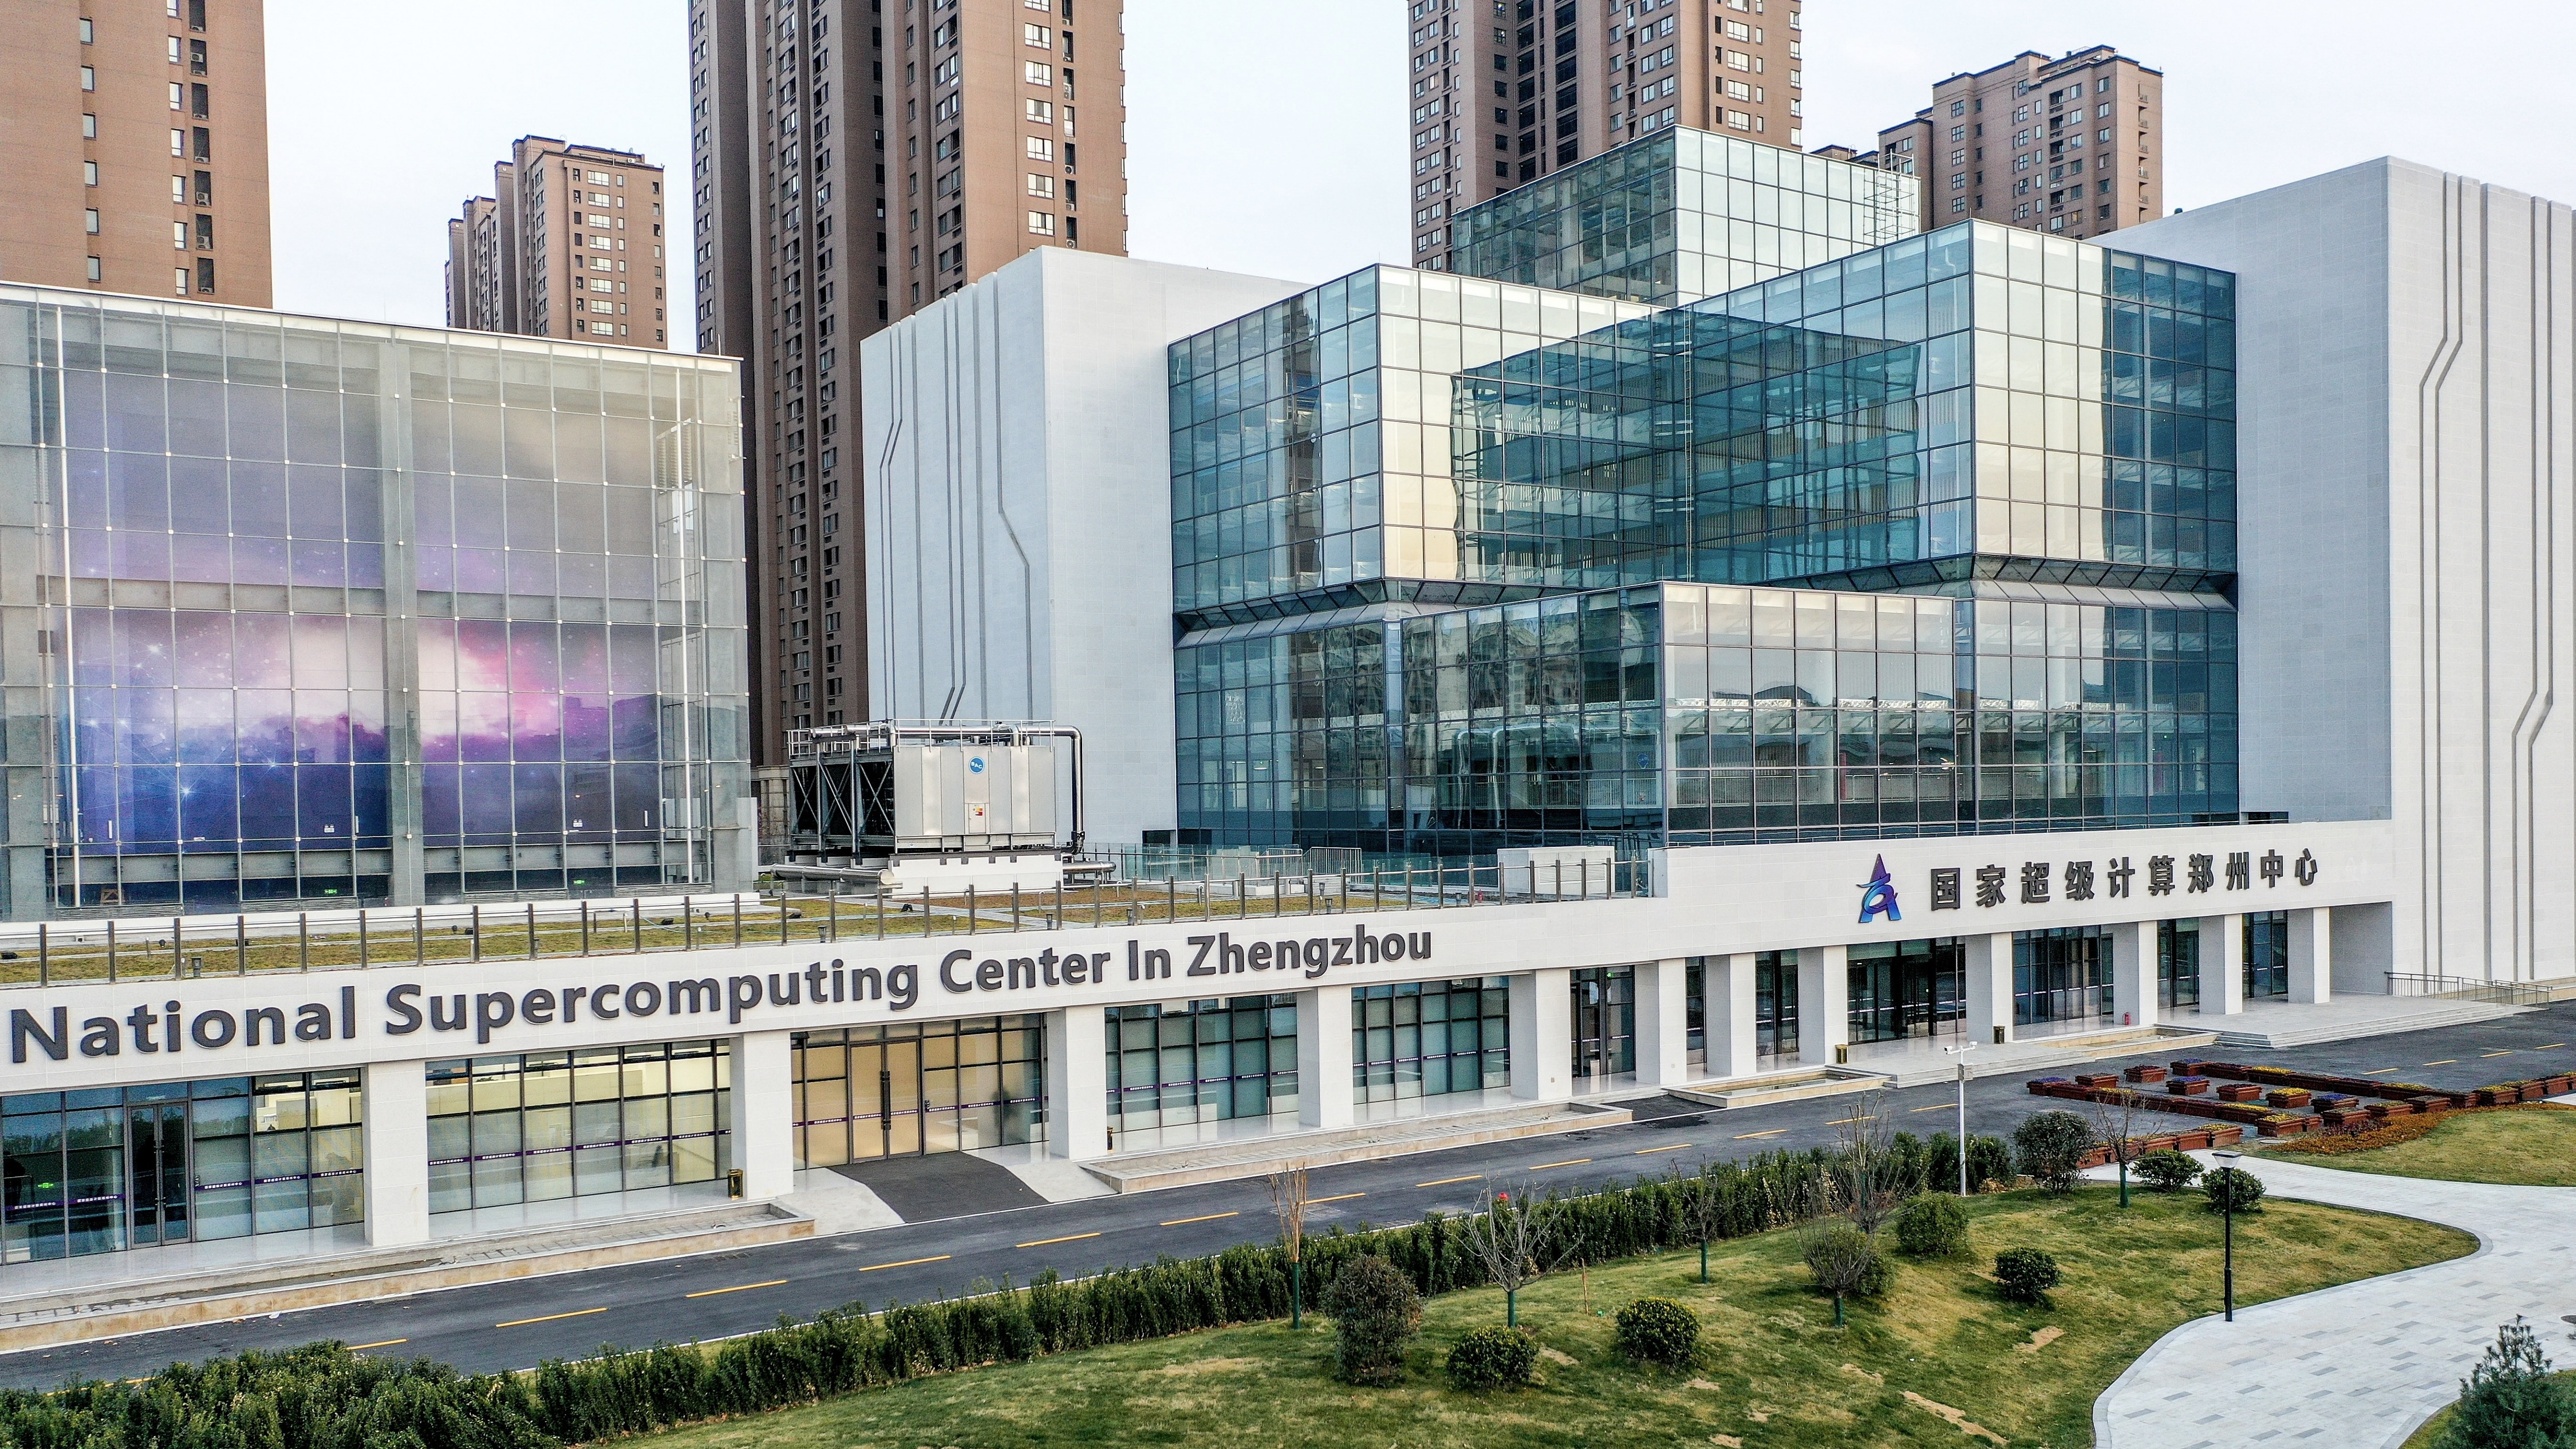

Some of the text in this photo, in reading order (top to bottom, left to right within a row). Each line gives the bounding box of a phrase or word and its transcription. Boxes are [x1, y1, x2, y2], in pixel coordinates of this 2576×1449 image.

[1930, 848, 2318, 911] 国家超级计算郑州中心
[11, 923, 1431, 1064] National Supercomputing Center In Zhengzhou
